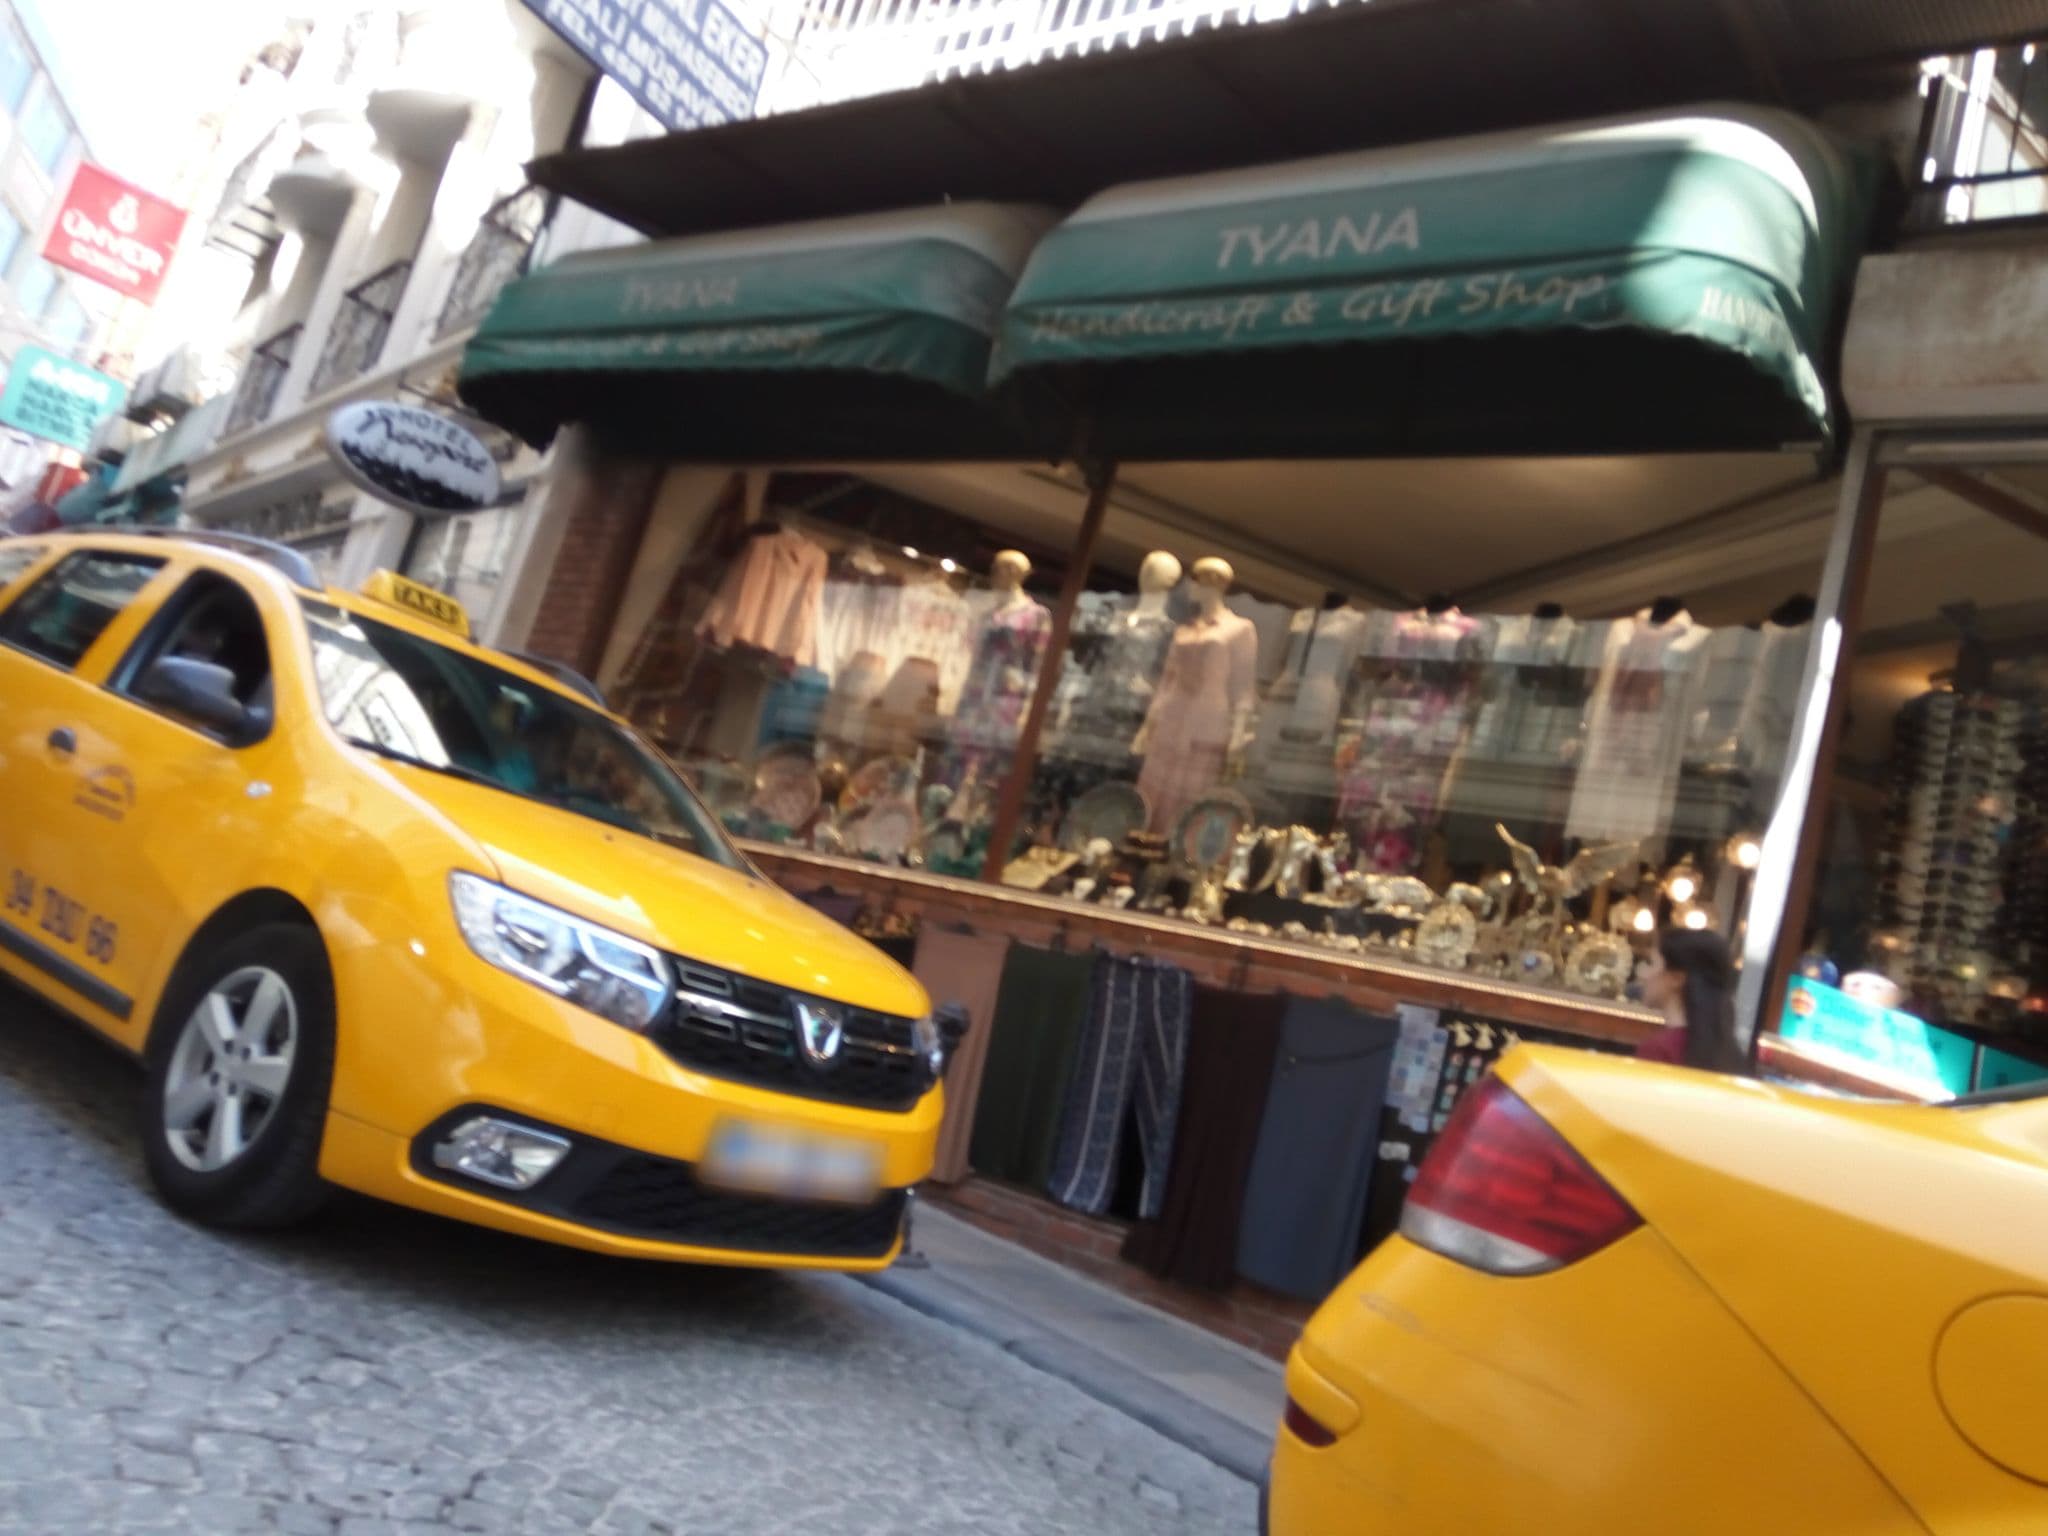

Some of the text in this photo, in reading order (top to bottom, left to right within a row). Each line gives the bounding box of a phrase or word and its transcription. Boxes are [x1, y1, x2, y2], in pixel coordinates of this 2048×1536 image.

[701, 3, 766, 93] EKER
[1216, 207, 1421, 269] TYANA
[1281, 290, 1319, 325] &
[1341, 275, 1451, 329] Gift
[1457, 273, 1607, 314] Shop
